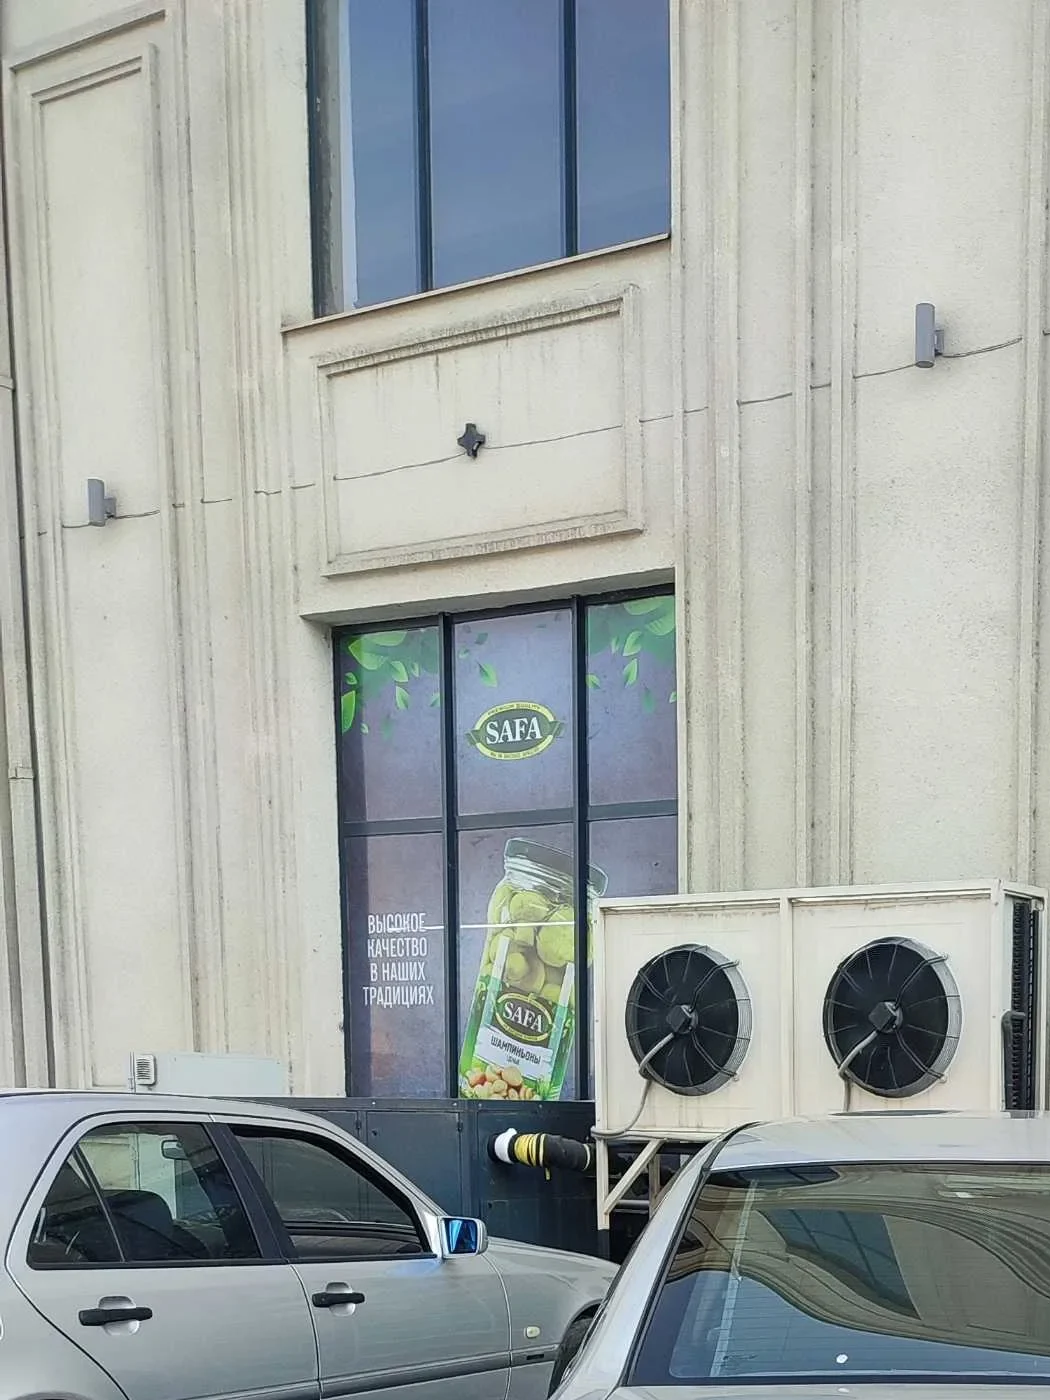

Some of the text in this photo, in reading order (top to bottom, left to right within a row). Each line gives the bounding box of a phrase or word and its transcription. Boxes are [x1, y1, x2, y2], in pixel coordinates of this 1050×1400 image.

[486, 716, 543, 745] SAFA
[367, 912, 427, 935] ВЫСОКОЕ
[367, 937, 428, 958] КАЧЕСТВО
[370, 961, 426, 982] В НАШИХ
[362, 985, 434, 1009] ТРАДИЦИЯХ
[503, 1001, 542, 1033] SAFA
[490, 1035, 541, 1065] ШАМПИНЬОНЫ
